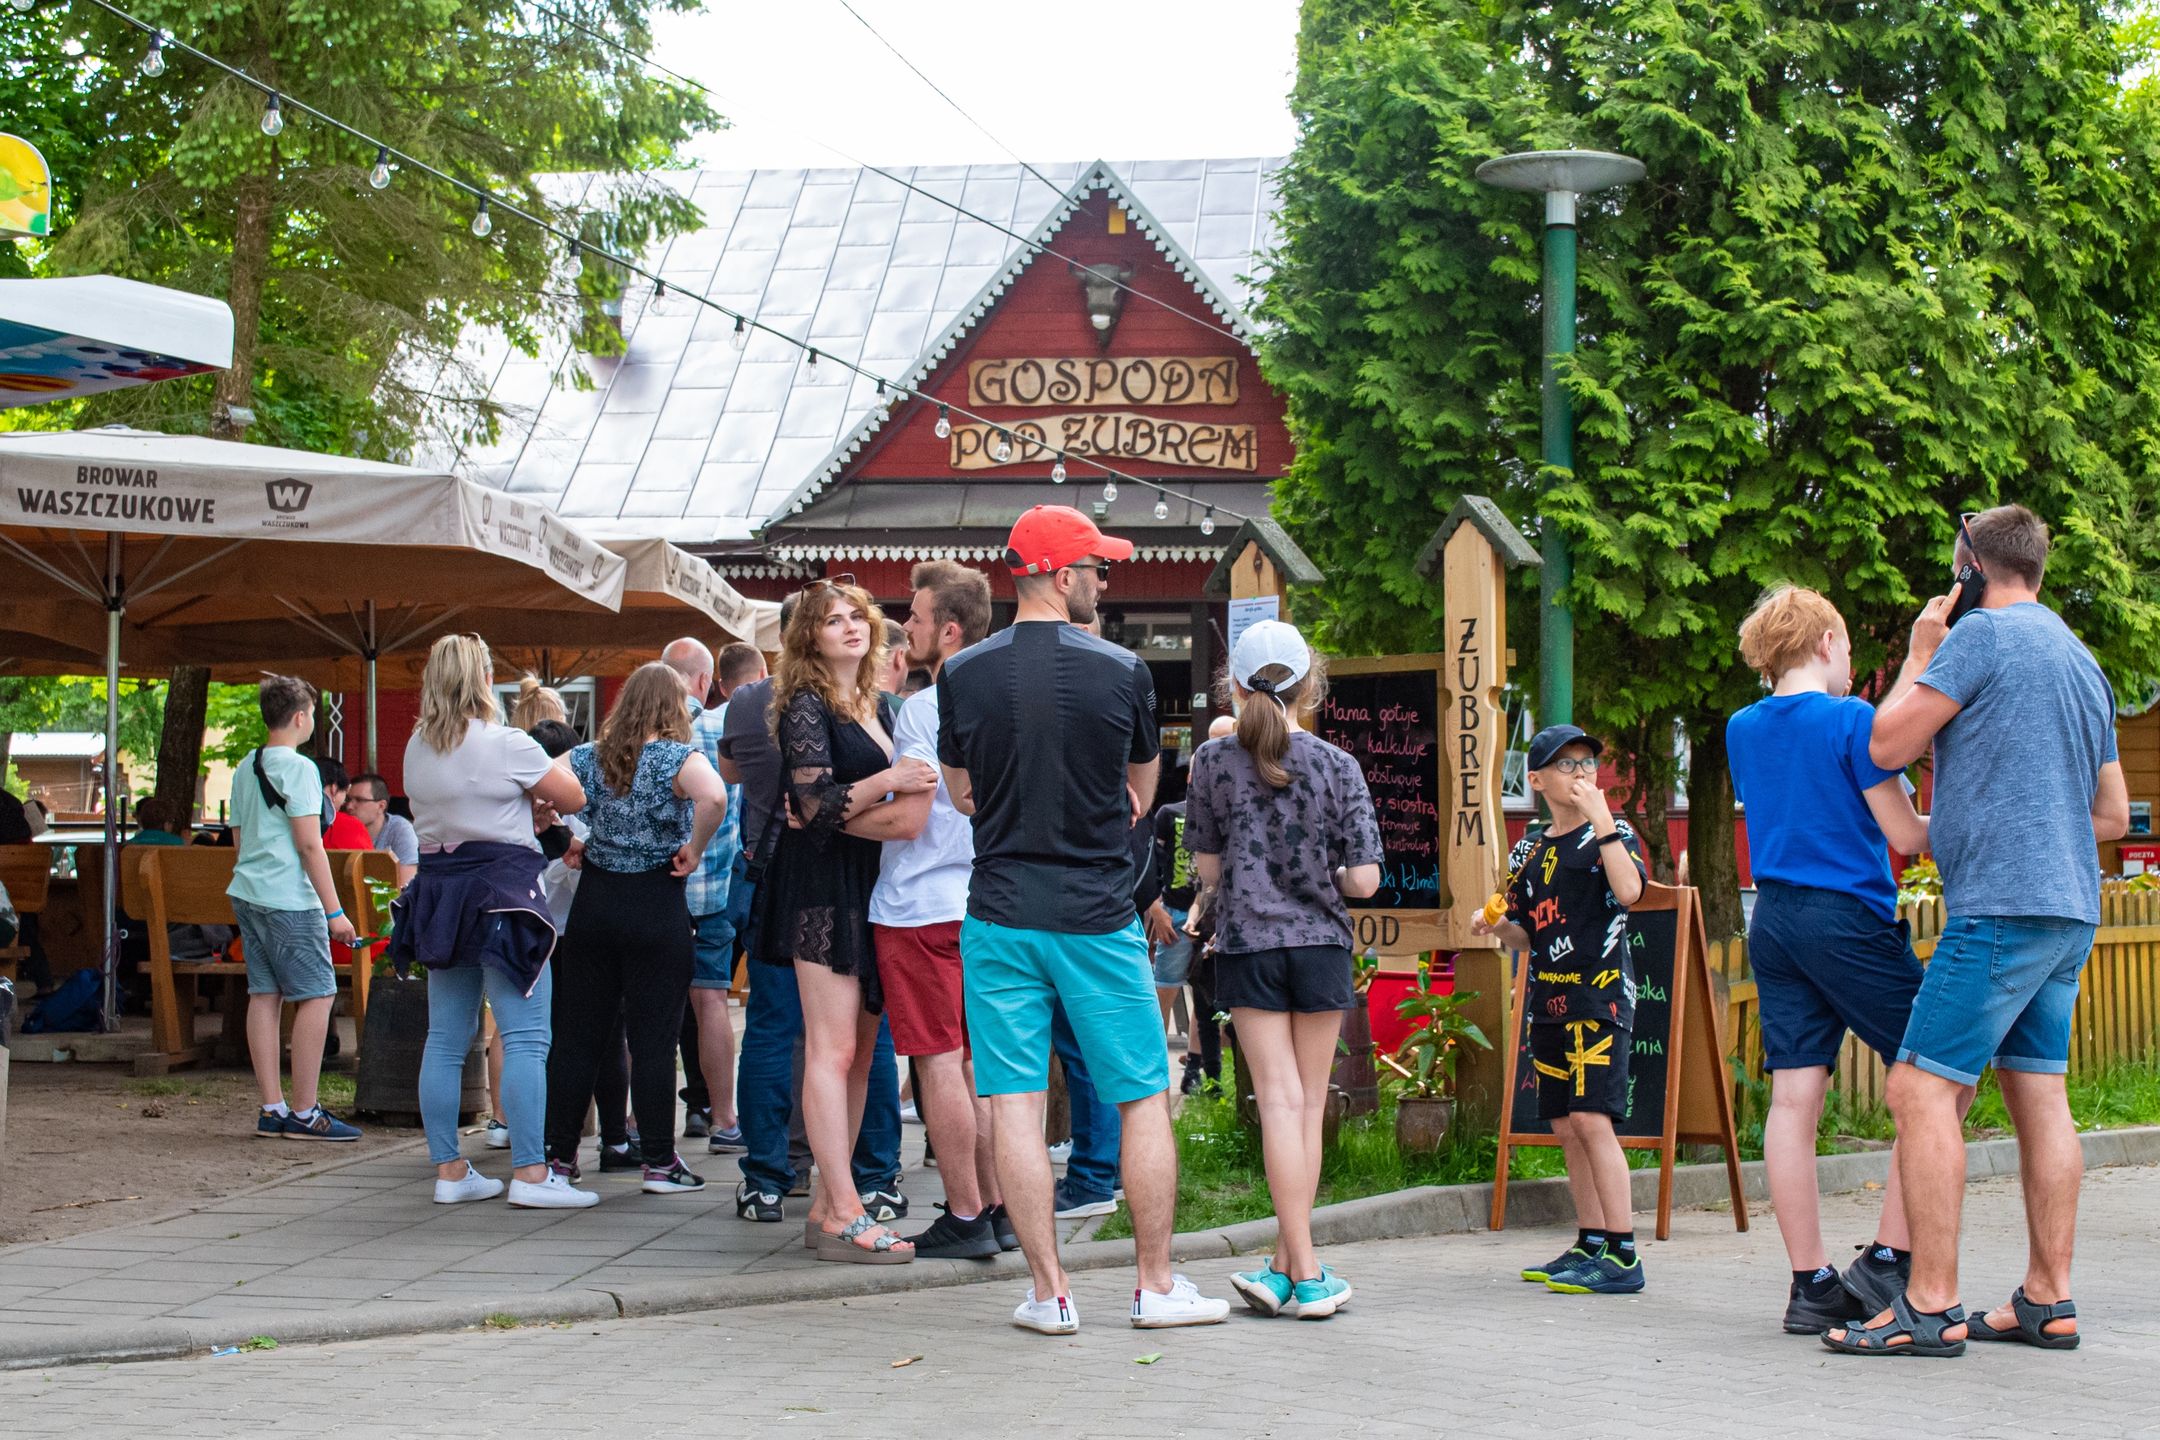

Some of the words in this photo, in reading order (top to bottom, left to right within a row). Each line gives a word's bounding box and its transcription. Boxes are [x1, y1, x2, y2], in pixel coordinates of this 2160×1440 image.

[974, 358, 1237, 405] GOSPODA
[951, 422, 1047, 466] POD
[76, 465, 158, 489] BROWAR
[17, 487, 216, 524] WASZCZUKOWE
[1324, 696, 1371, 721] Mama
[1379, 702, 1420, 731] gotuje
[1367, 730, 1428, 765] kalkuluje
[1350, 914, 1400, 946] OD
[1538, 970, 1583, 985] AWESOME
